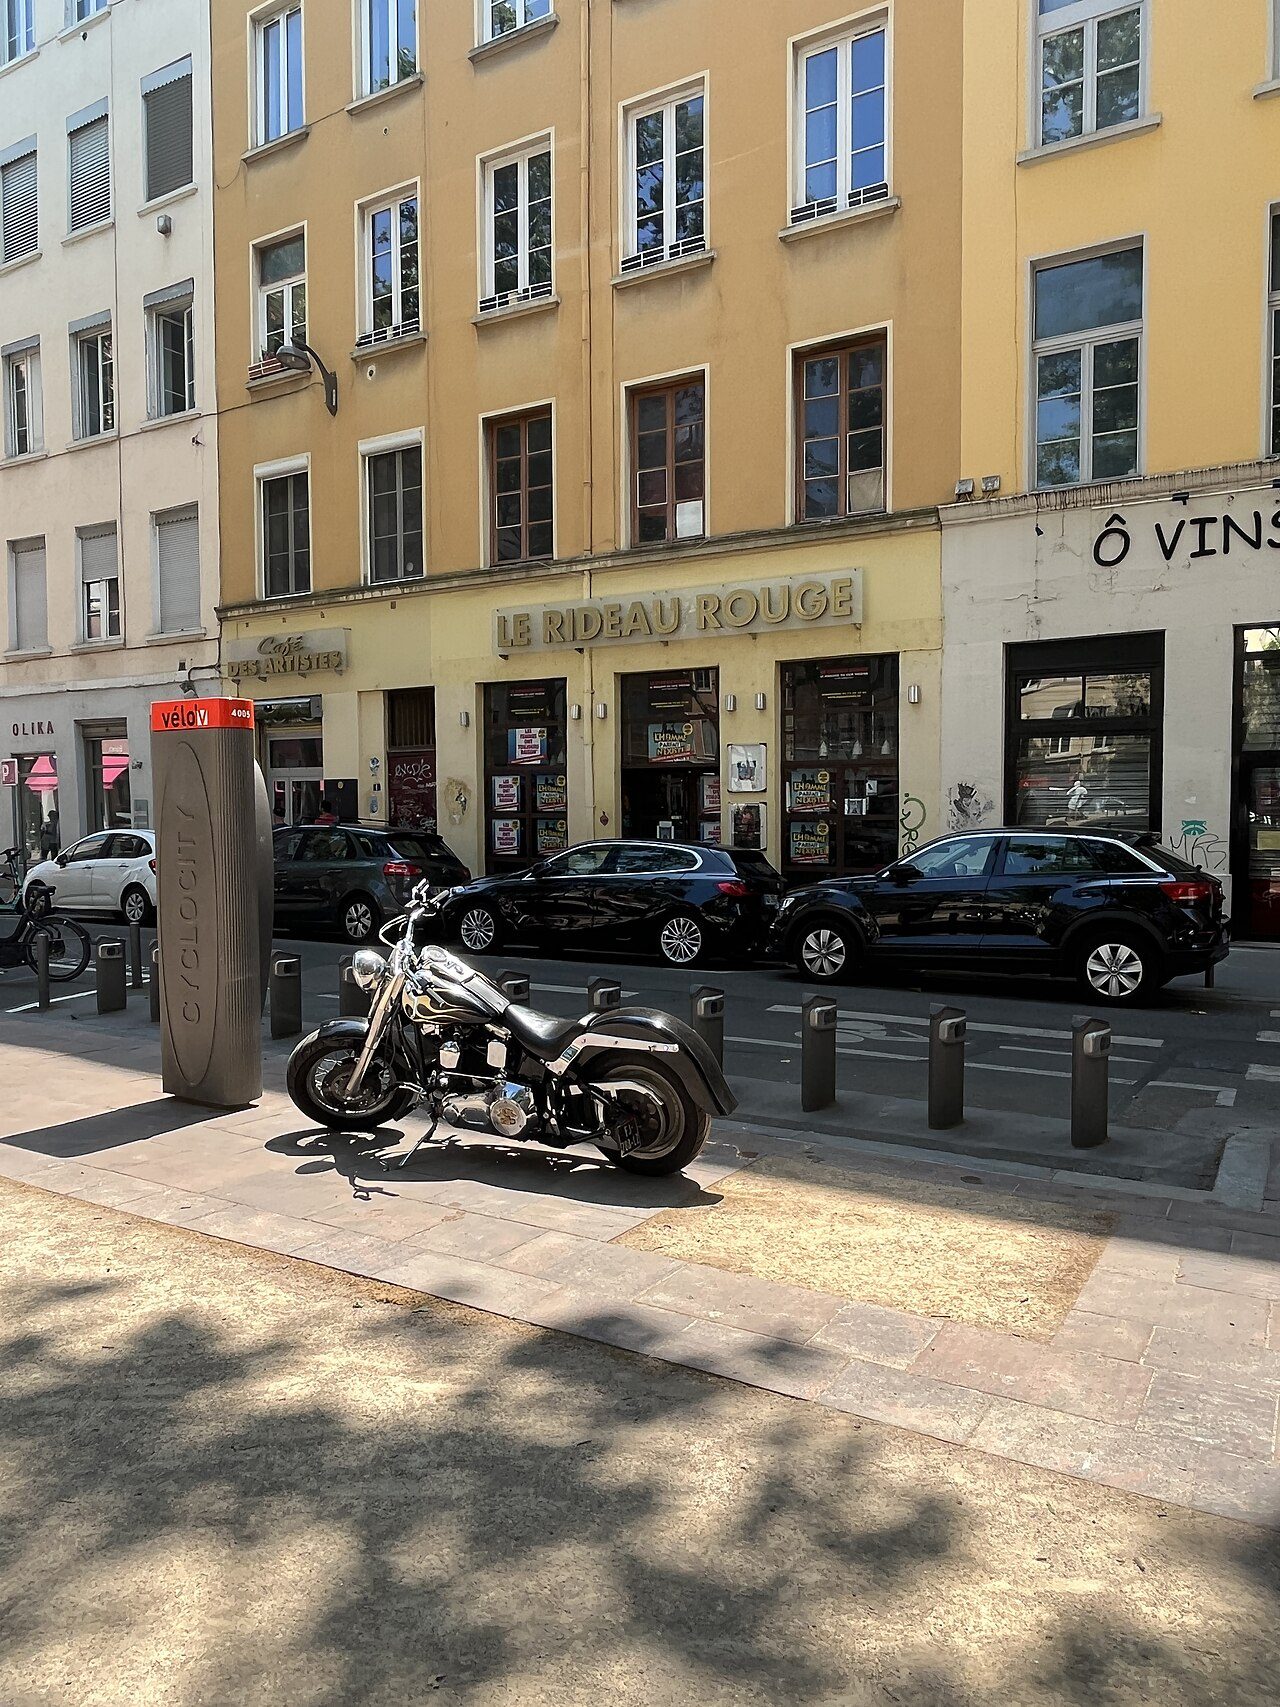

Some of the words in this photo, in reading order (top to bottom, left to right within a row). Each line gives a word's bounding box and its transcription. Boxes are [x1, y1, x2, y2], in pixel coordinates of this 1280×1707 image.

[1093, 513, 1131, 567] Ô
[497, 614, 532, 648] LE
[542, 597, 681, 644] RIDEAU
[696, 577, 854, 630] ROUGE
[257, 635, 305, 656] Café
[228, 660, 260, 677] DES
[265, 651, 343, 674] ARTISTES
[231, 709, 251, 719] 4005
[12, 720, 55, 736] OLIKA
[176, 805, 200, 1024] CYCLOCITY
